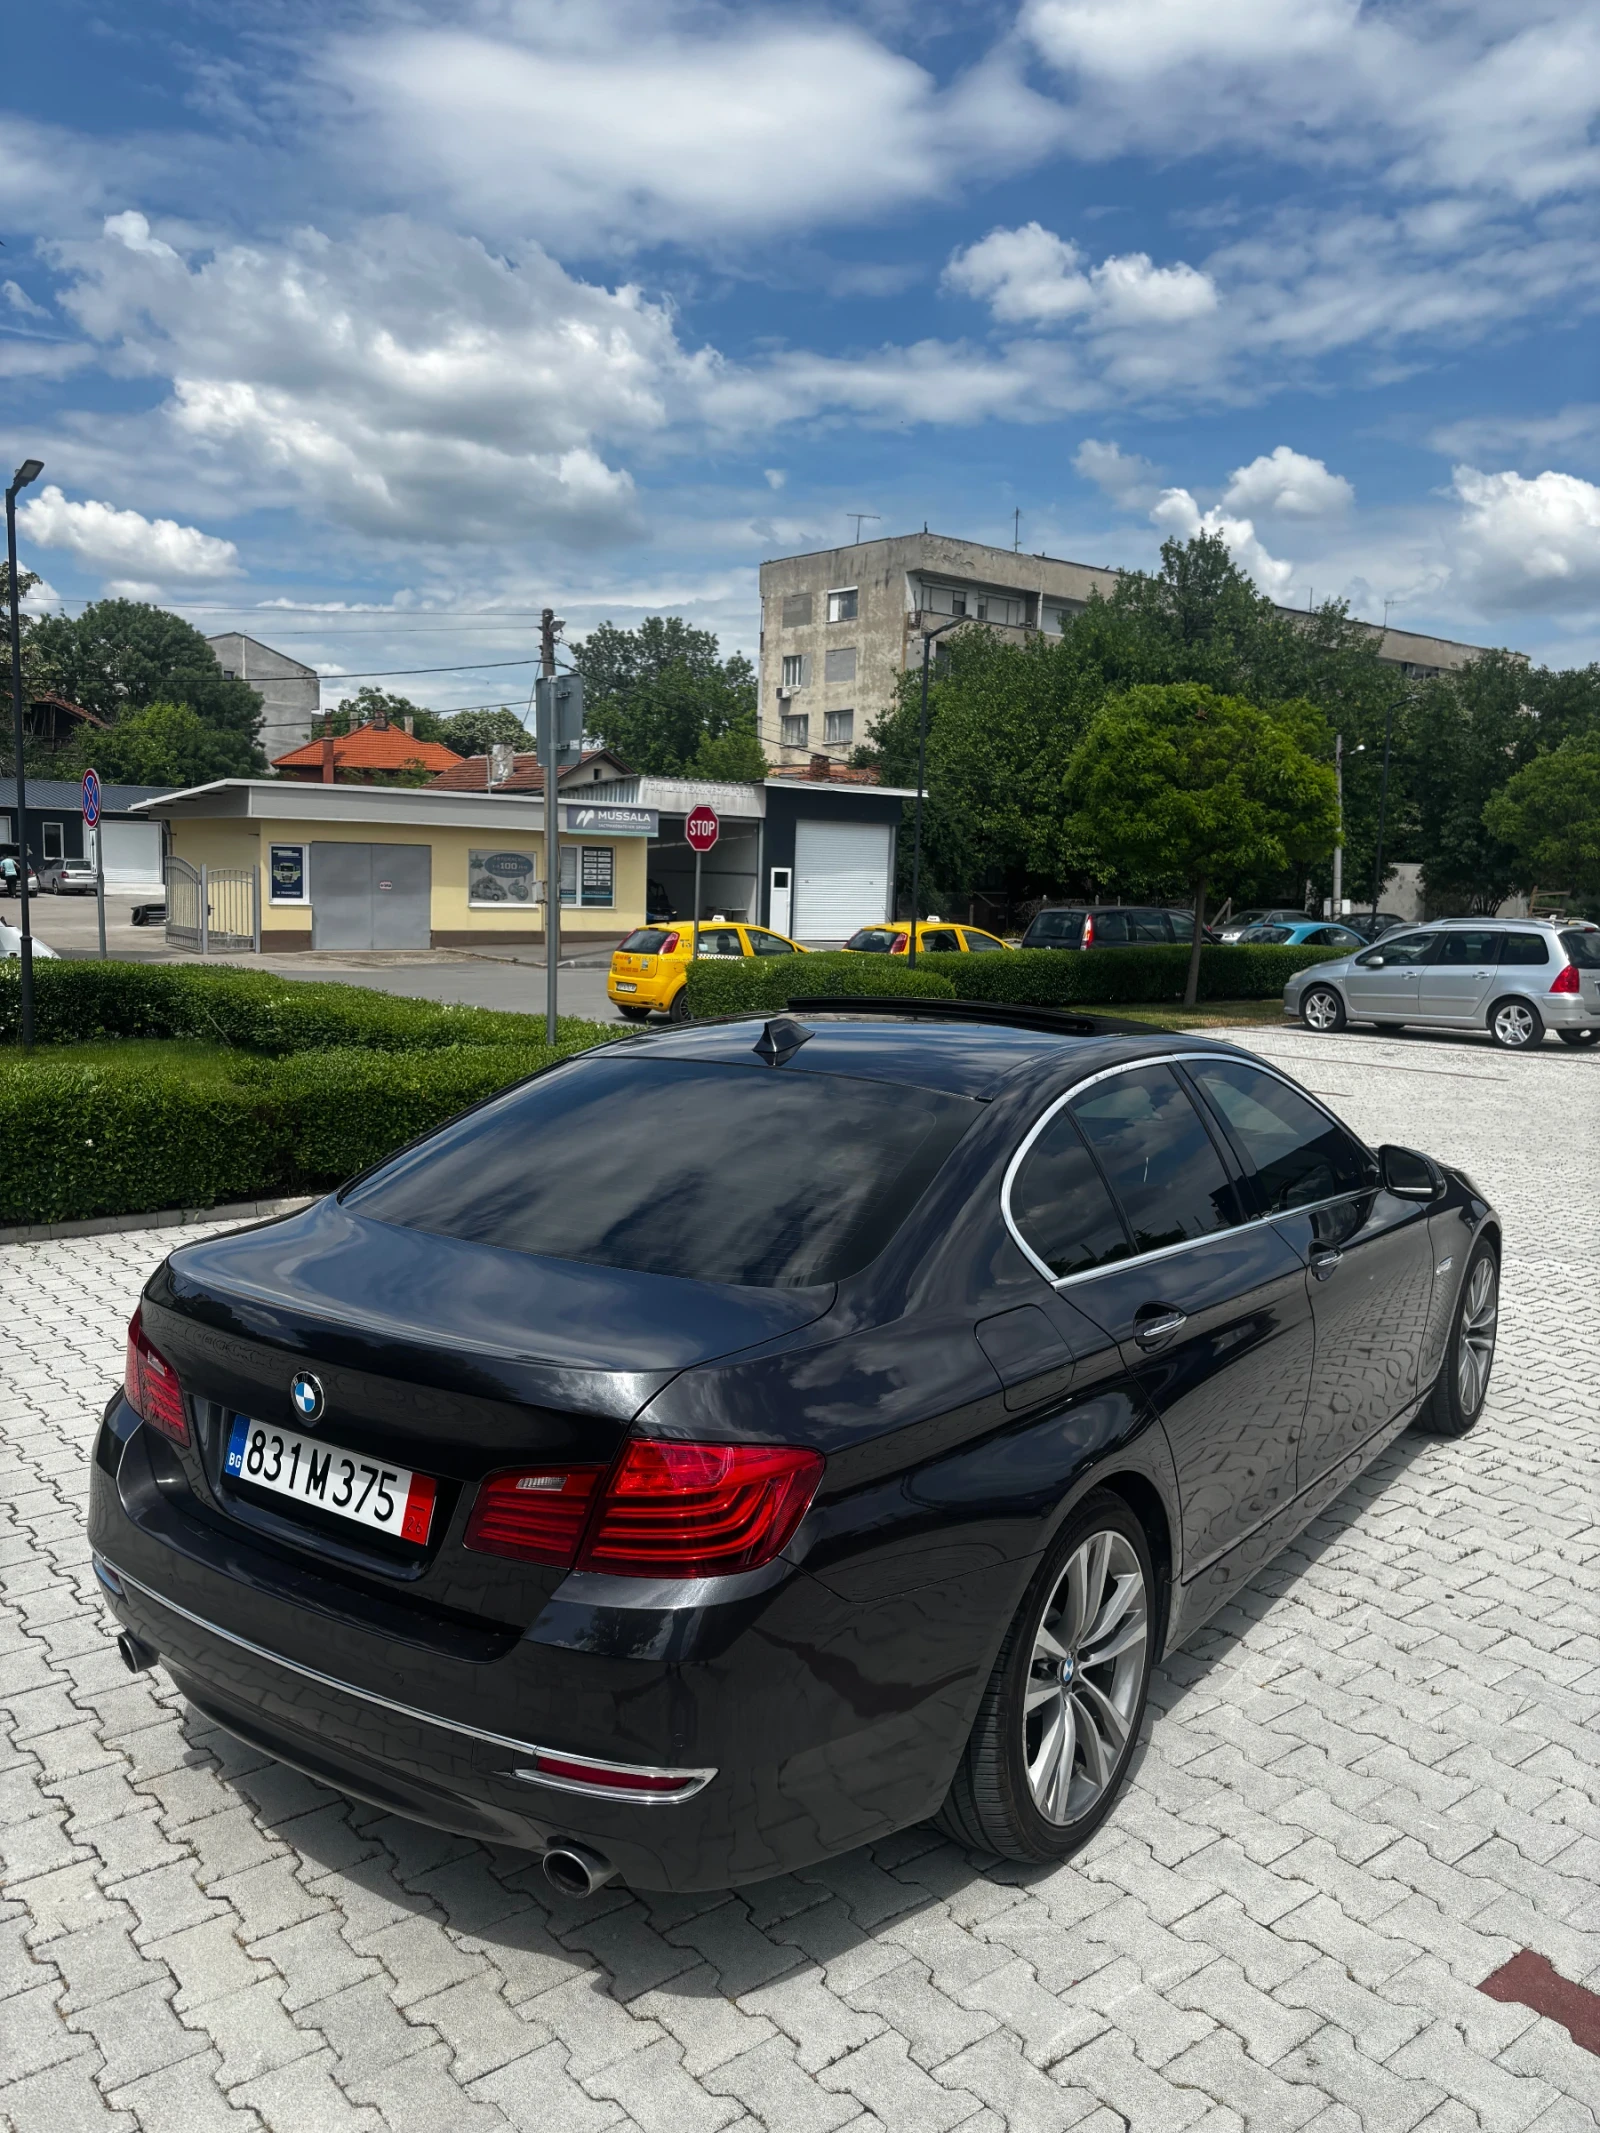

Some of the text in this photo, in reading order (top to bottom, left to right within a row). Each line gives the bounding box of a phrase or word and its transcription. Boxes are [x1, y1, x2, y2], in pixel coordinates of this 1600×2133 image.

[598, 811, 651, 822] MUSSALA
[689, 819, 716, 837] STOP
[500, 862, 518, 870] 100
[228, 1452, 242, 1469] BG
[405, 1516, 423, 1536] 26
